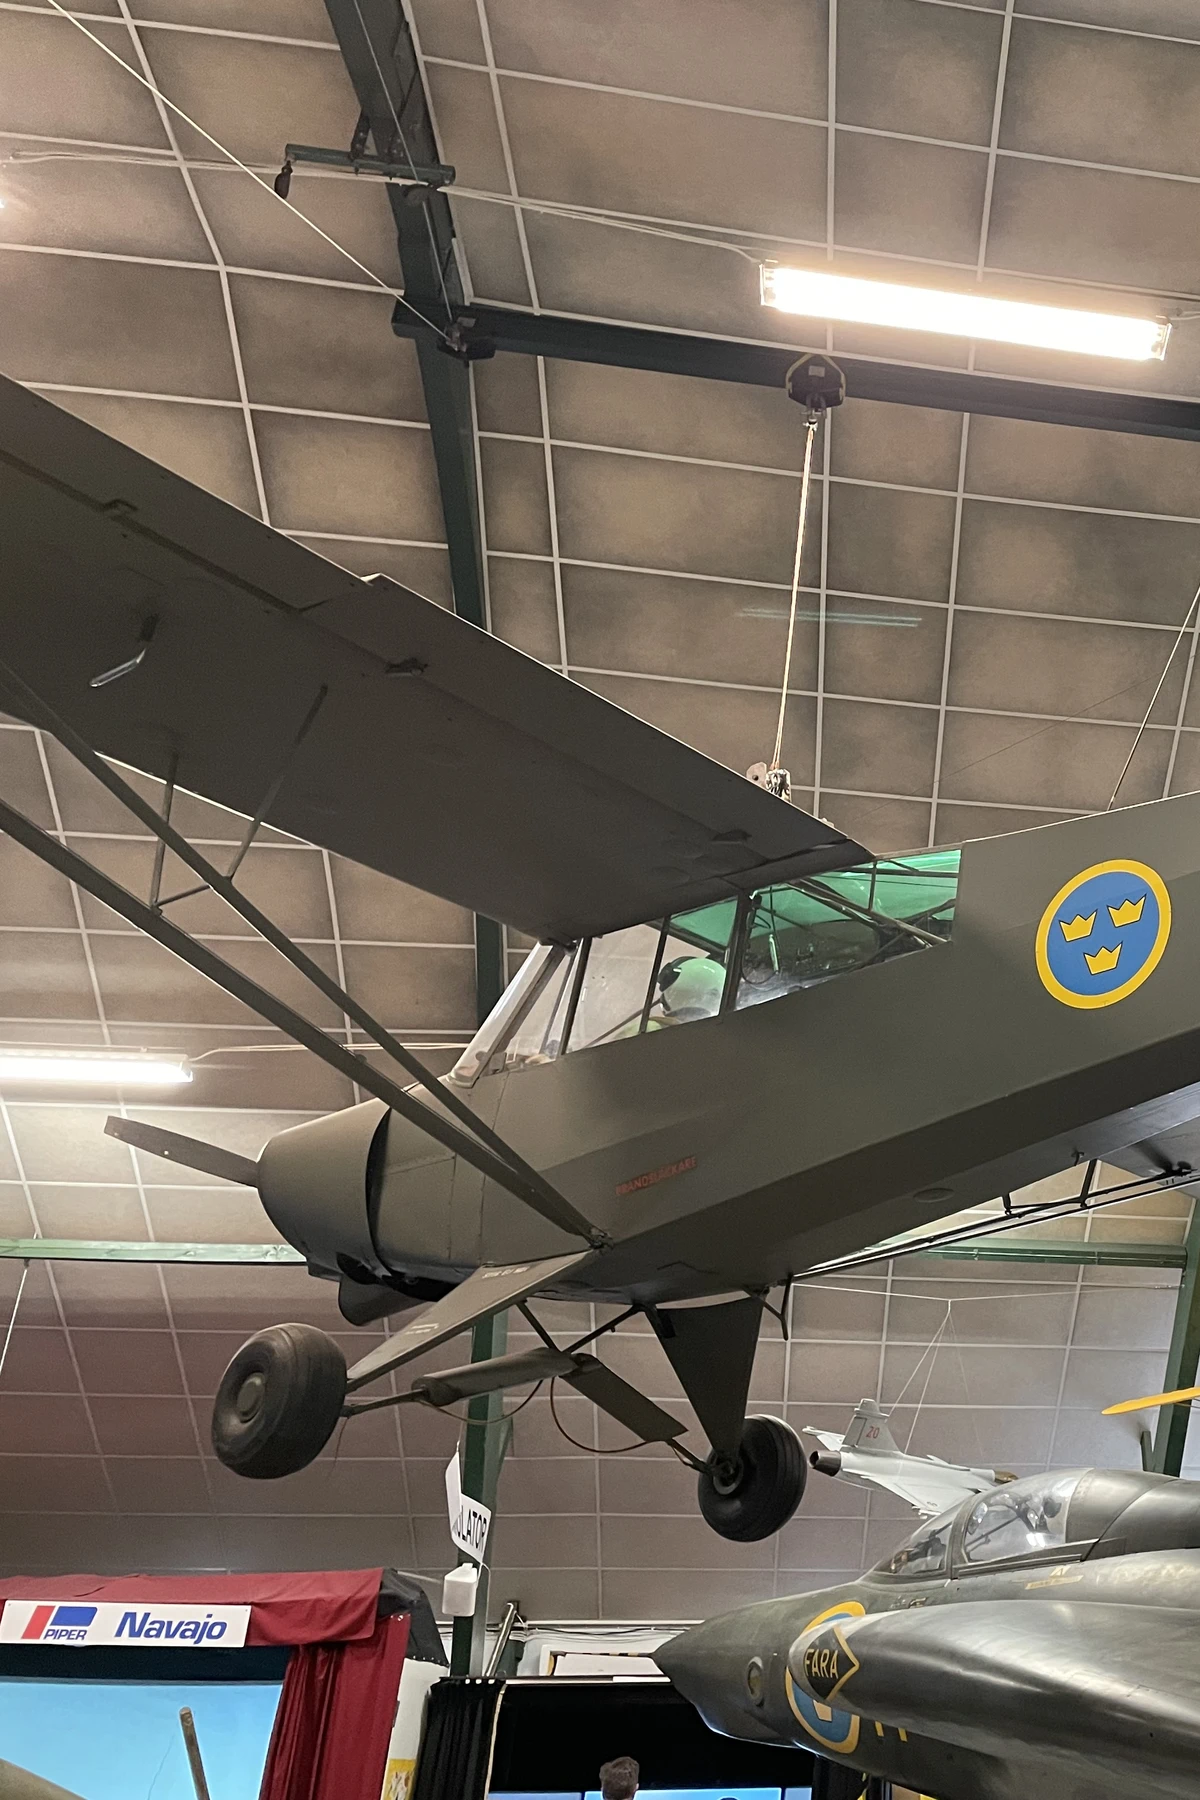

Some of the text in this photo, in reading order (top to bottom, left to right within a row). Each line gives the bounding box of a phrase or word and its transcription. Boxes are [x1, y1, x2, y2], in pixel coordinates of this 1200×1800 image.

[43, 1611, 228, 1645] PIPER Navajo
[804, 1648, 839, 1680] FARA
